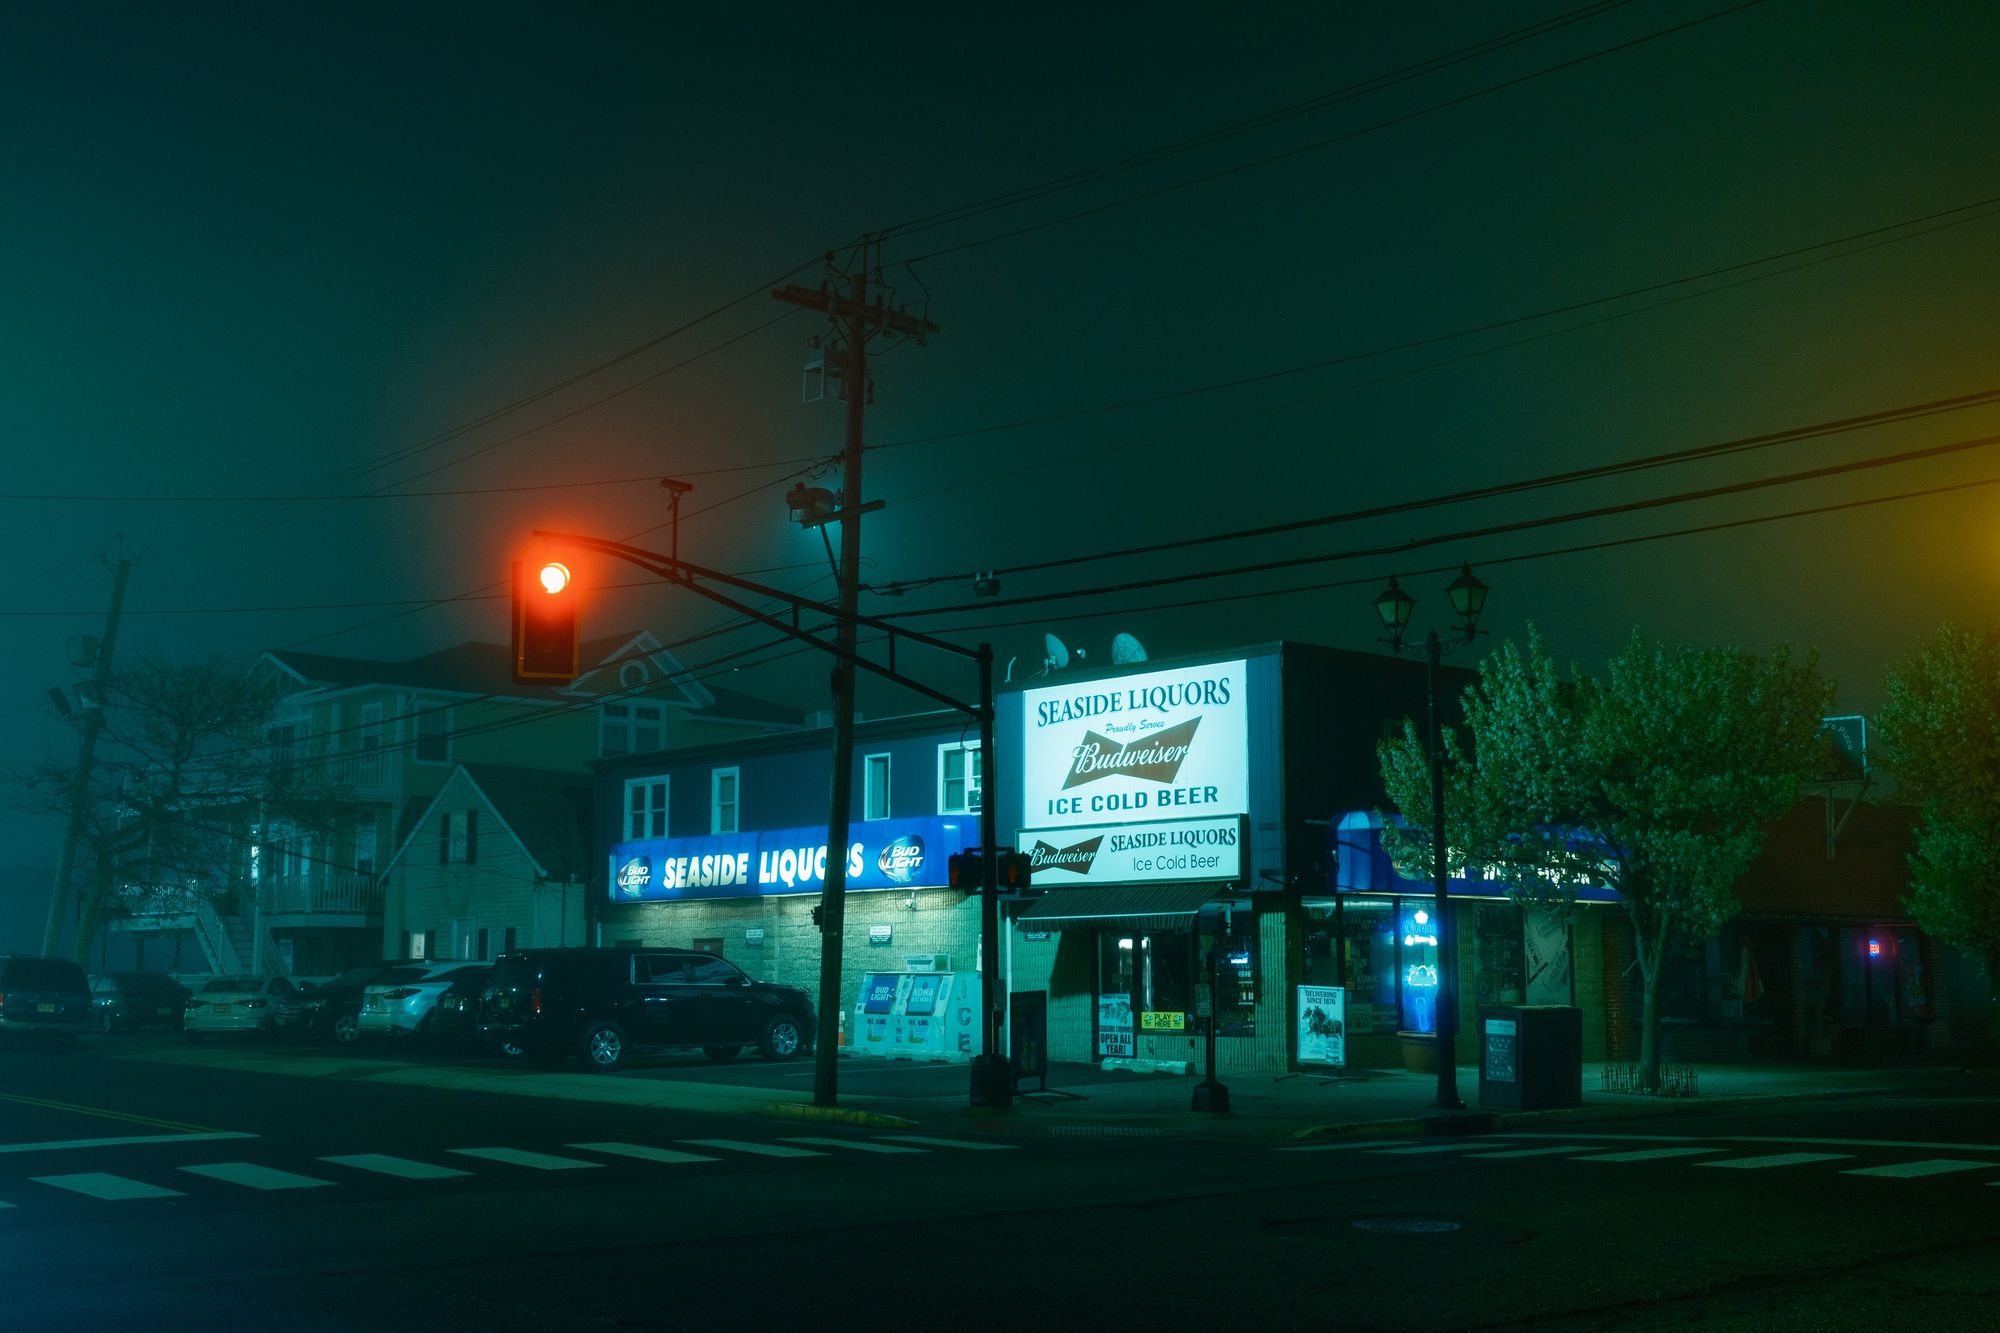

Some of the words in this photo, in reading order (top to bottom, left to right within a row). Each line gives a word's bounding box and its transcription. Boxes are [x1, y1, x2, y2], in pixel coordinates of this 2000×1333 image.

[1037, 691, 1123, 727] SEASIDE
[1129, 677, 1231, 713] LIQUORS
[1105, 721, 1137, 734] Proudly
[1139, 719, 1165, 731] Serves
[1072, 741, 1189, 774] Budweiser
[1048, 797, 1083, 815] ICE
[1091, 791, 1148, 812] COLD
[1157, 785, 1219, 807] BEER
[1110, 832, 1167, 852] SEASIDE
[1170, 828, 1236, 848] LIQUORS
[891, 846, 920, 857] BUD
[1029, 847, 1097, 867] Budweiser
[663, 853, 749, 889] SEASIDE
[758, 843, 865, 887] LIQUOS
[884, 857, 923, 868] LIGHT
[1133, 857, 1152, 871] Ice
[1156, 855, 1187, 871] Cold
[1190, 854, 1220, 869] Beer
[627, 865, 648, 875] BUD
[621, 875, 651, 885] LIGHT
[875, 986, 889, 994] BUD
[912, 987, 934, 997] KONA
[1305, 991, 1337, 999] DELIVERING
[870, 993, 890, 1001] LIGHT
[1154, 1013, 1171, 1021] PLAY
[1154, 1020, 1171, 1028] HERE
[1100, 1033, 1118, 1044] OPEN
[1119, 1033, 1132, 1044] ALL
[1106, 1043, 1126, 1055] YEAR!
